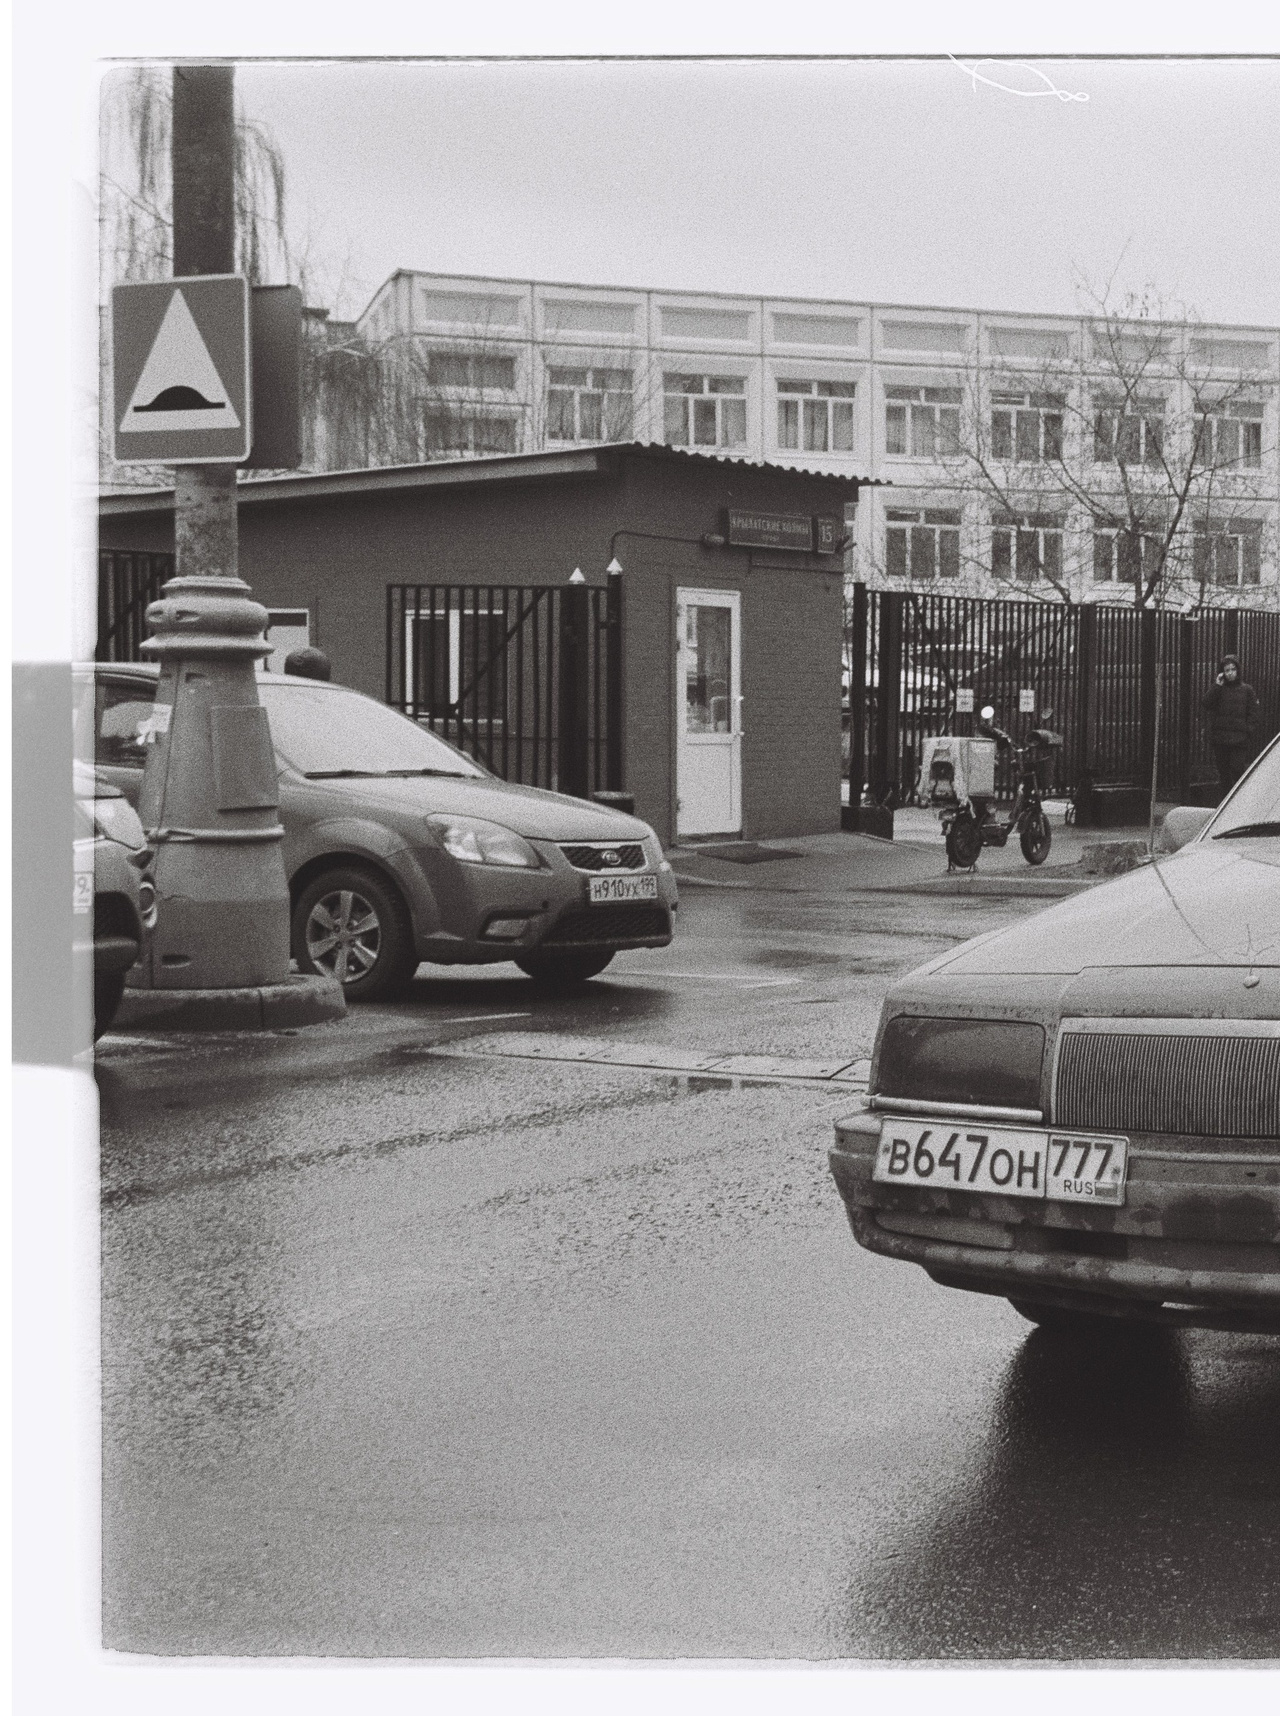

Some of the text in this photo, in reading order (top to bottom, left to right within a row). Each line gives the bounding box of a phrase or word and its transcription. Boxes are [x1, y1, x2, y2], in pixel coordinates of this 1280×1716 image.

[821, 525, 833, 543] 15
[593, 879, 639, 899] Н910УХ
[888, 1131, 1114, 1189] В647ОН 777
[1063, 1179, 1093, 1195] RUS
